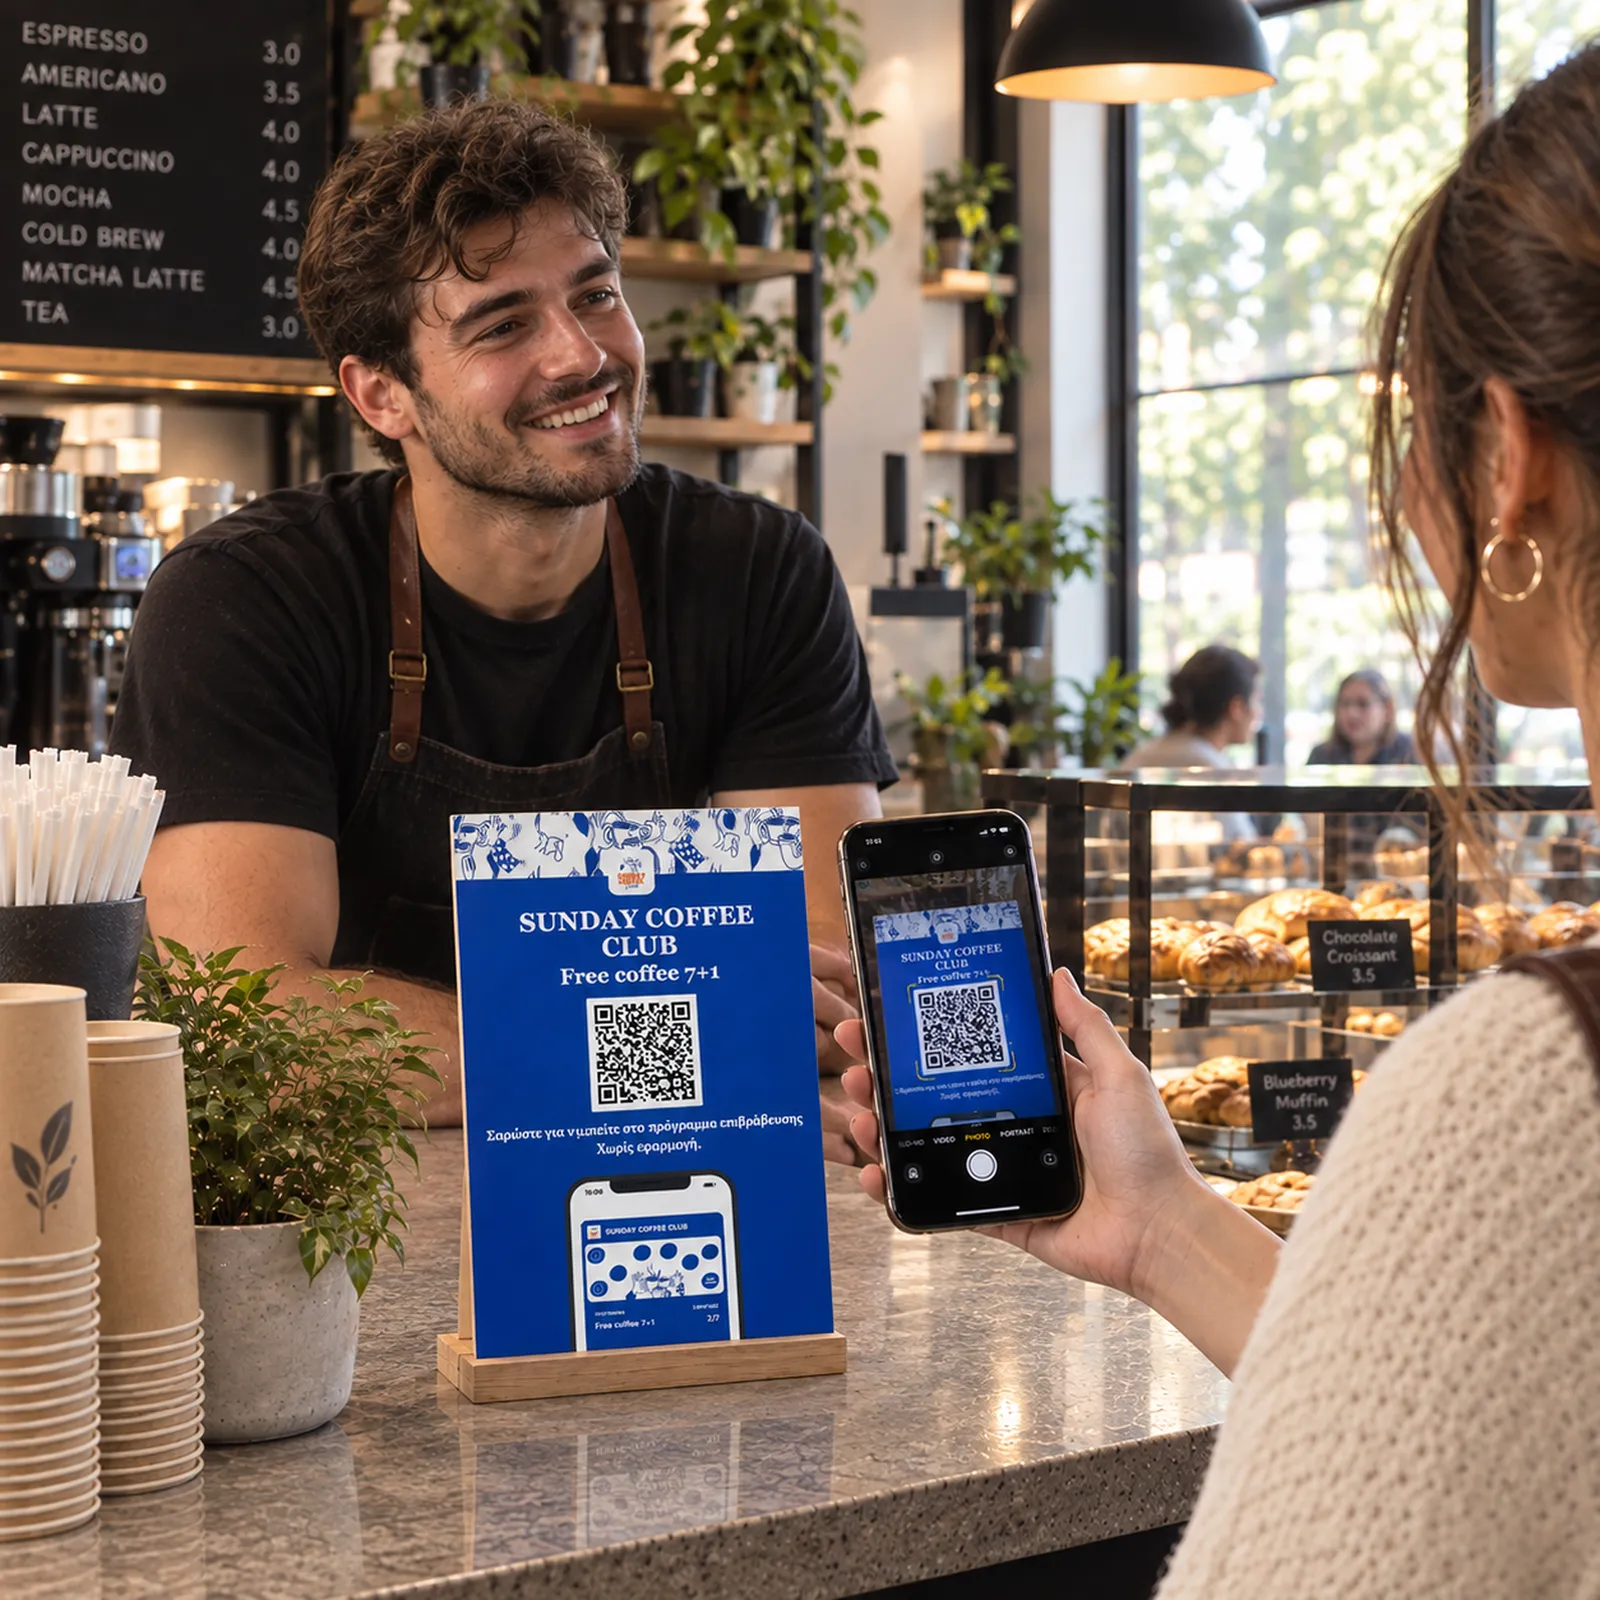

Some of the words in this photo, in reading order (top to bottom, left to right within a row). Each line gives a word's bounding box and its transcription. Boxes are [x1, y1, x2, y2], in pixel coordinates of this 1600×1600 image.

[22, 21, 148, 54] ESPRESSO
[262, 40, 300, 65] 3.0
[21, 63, 167, 95] AMERICANO
[263, 80, 300, 105] 3.5
[22, 102, 98, 129] LATTE
[261, 119, 299, 144] 4.0
[22, 142, 174, 173] CAPPUCCINO
[261, 159, 299, 183] 4.0
[22, 183, 112, 209] MOCHA
[261, 198, 299, 222] 4.5
[22, 221, 87, 246] COLD
[97, 226, 165, 251] BREW
[261, 237, 299, 261] 4.0
[22, 261, 123, 287] MATCHA
[133, 267, 205, 291] LATTE
[261, 277, 298, 300] 4.5
[22, 300, 69, 324] TEA
[261, 315, 299, 339] 3.0
[519, 908, 639, 933] SUNDAY
[645, 904, 754, 928] COFFEE
[601, 934, 678, 958] CLUB
[1322, 929, 1398, 945] Chocolate
[901, 949, 951, 963] SUNDAY
[954, 943, 1003, 957] COFFEE
[1327, 949, 1399, 964] Croissant
[560, 967, 610, 986] Free
[615, 964, 680, 984] coffee
[683, 965, 720, 984] 7+1
[935, 959, 969, 971] CLUB
[1351, 967, 1376, 984] 3.5
[1263, 1073, 1338, 1092] Blueberry
[1275, 1093, 1328, 1111] Muffin
[622, 1123, 645, 1135] στο
[1292, 1114, 1317, 1131] 3.5
[965, 1132, 991, 1142] PHOTO
[596, 1141, 635, 1157] Χωρίς
